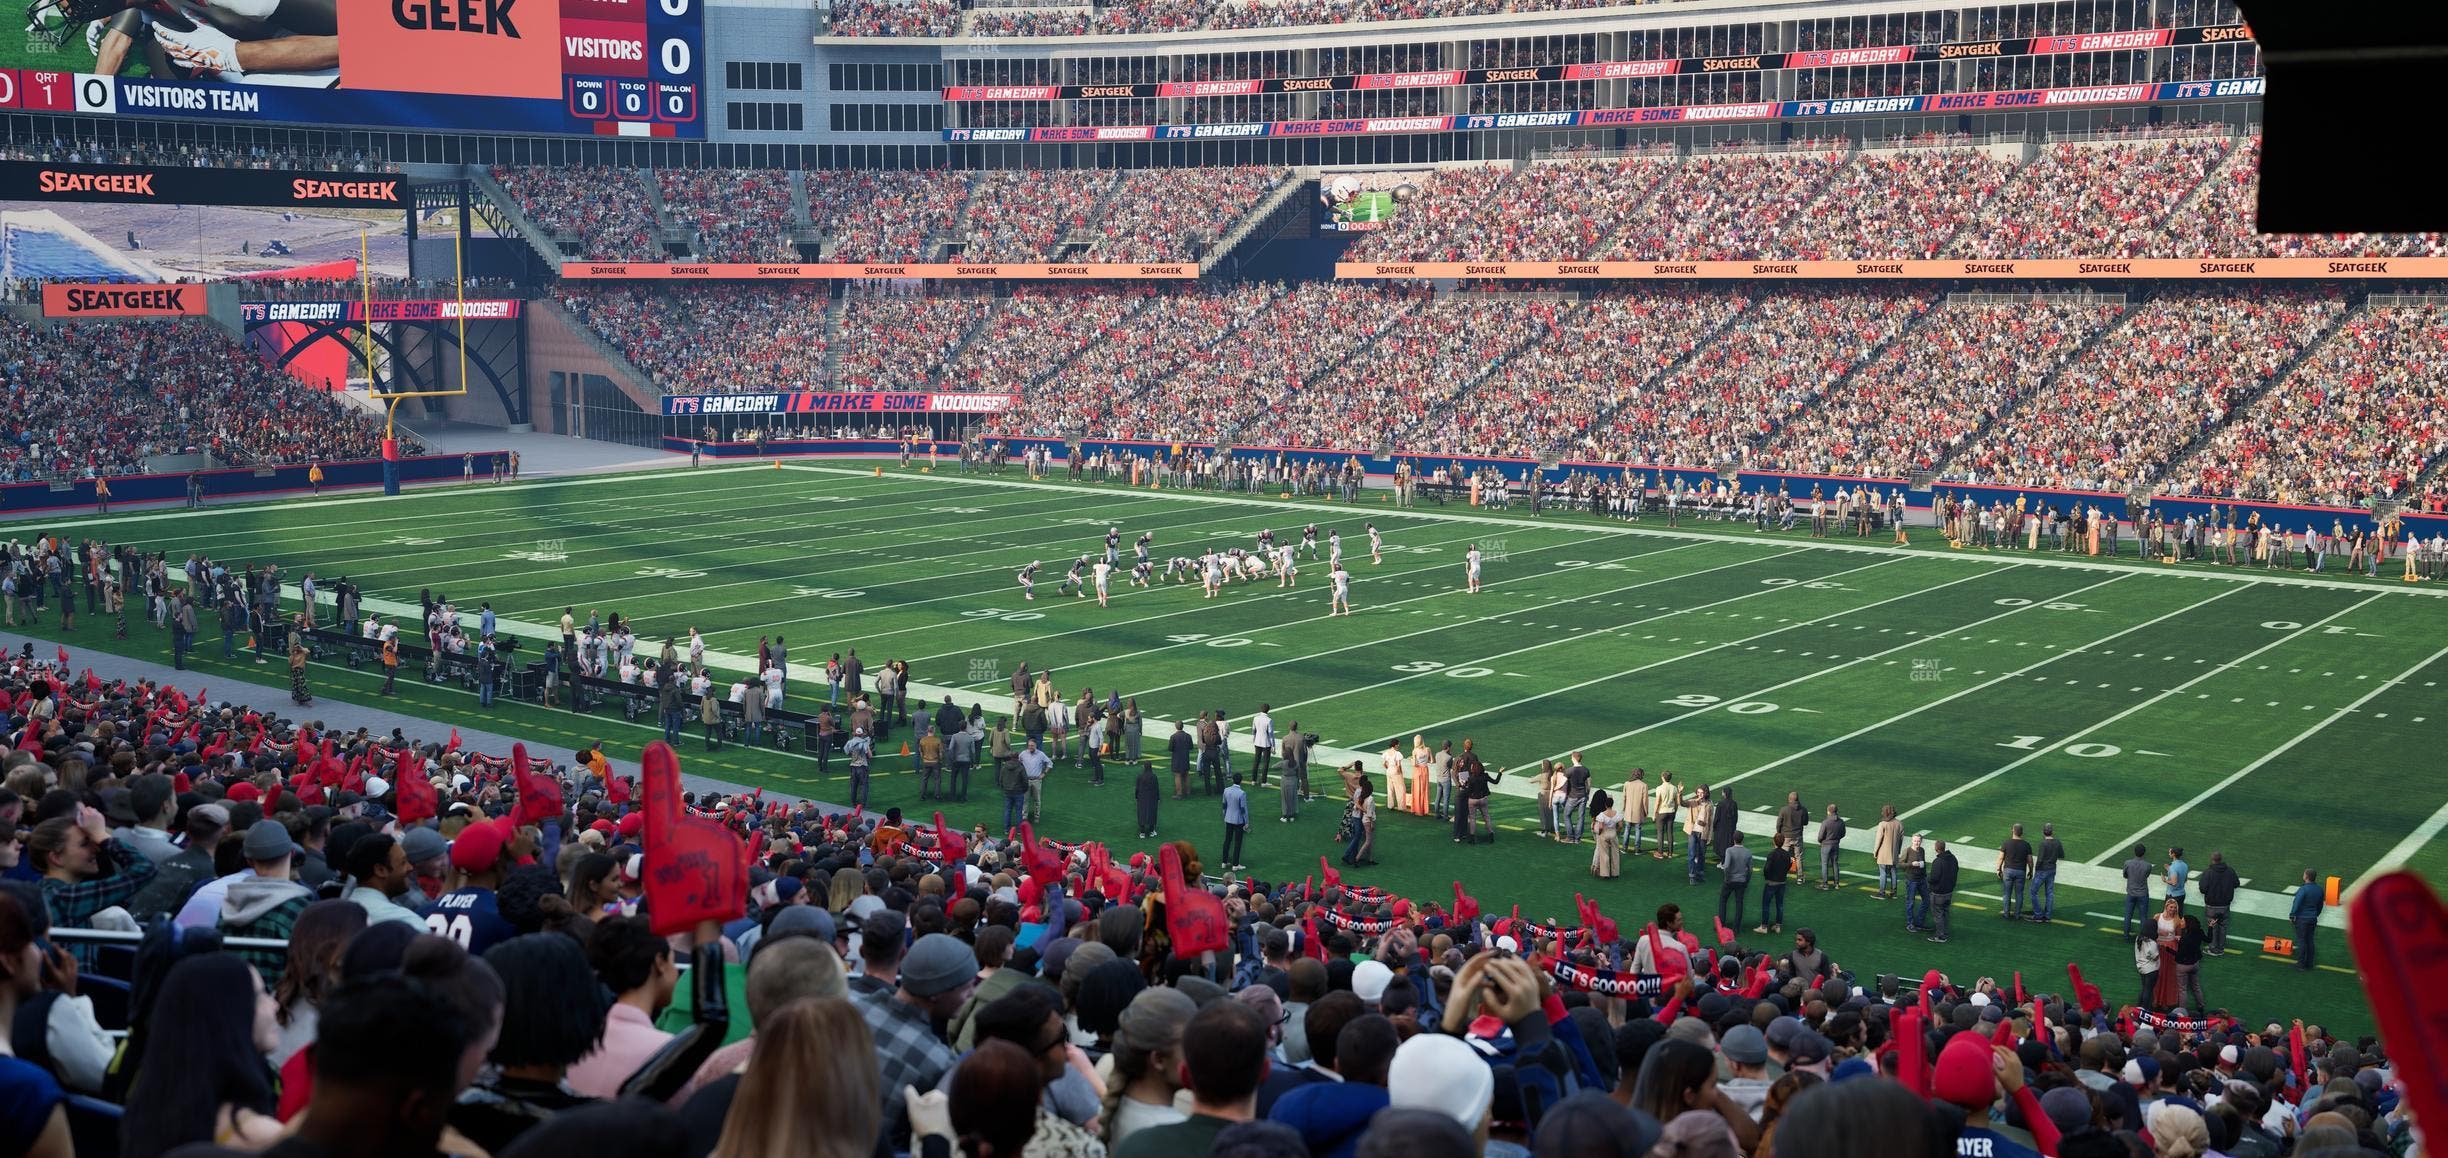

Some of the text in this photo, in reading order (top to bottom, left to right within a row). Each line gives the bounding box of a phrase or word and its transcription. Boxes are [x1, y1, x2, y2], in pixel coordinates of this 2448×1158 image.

[392, 0, 521, 39] GEEK
[565, 36, 643, 60] VISITORS
[2050, 32, 2159, 50] IT'S GAMEDAY!
[661, 38, 690, 74] 0
[1804, 50, 1900, 65] IT'S GAMEDAY!
[1940, 43, 2001, 58] SEATGEEK
[1580, 62, 1668, 77] IT'S GAMEDAY!
[1703, 58, 1760, 71] SEATGEEK
[36, 72, 58, 84] QRT
[1370, 74, 1454, 86] IT'S GAMEDAY!
[1486, 68, 1539, 82] SEATGEEK
[576, 80, 602, 90] DOWN
[620, 82, 646, 91] TO GO
[660, 84, 692, 93] BALL ON
[1172, 82, 1252, 95] IT'S GAMEDAY!
[1284, 78, 1332, 91] SEATGEEK
[2176, 83, 2211, 97] IT'S
[42, 86, 52, 106] 1
[83, 78, 109, 108] 0
[124, 84, 258, 112] VISITORS TEAM
[961, 87, 1048, 98] IT'S GAMEDAY!
[1082, 86, 1134, 98] SEATGEEK
[1938, 86, 2144, 108] MAKE SOME NOOOOISE!!!
[582, 92, 598, 110] 0
[625, 93, 640, 112] 0
[668, 95, 683, 114] 0
[1796, 98, 1914, 114] IT'S GAMEDAY!
[1467, 112, 1570, 128] IT'S GAMEDAY!
[1592, 105, 1768, 122] MAKE SOME NOOOOISE!!!
[1166, 124, 1264, 138] IT'S GAMEDAY!
[1284, 118, 1442, 134] MAKE SOME NOOOOISE!!!
[950, 128, 1026, 140] IT'S GAMEDAY!
[1040, 127, 1148, 140] MAKE SOME NOOOOISE!!!
[39, 170, 155, 196] SEATGEEK
[292, 179, 399, 202] SEATGEEK
[590, 266, 626, 275] SEATGEEK
[671, 266, 710, 275] SEATGEEK
[758, 266, 800, 275] SEATGEEK
[864, 266, 905, 275] SEATGEEK
[957, 266, 997, 275] SEATGEEK
[1048, 266, 1088, 275] SEATGEEK
[1141, 266, 1182, 275] SEATGEEK
[1376, 266, 1415, 275] SEATGEEK
[1466, 266, 1506, 274] SEATGEEK
[1558, 265, 1600, 275] SEATGEEK
[1654, 265, 1697, 274] SEATGEEK
[1753, 264, 1798, 274] SEATGEEK
[1856, 264, 1903, 274] SEATGEEK
[1965, 264, 2014, 274] SEATGEEK
[2079, 263, 2132, 274] SEATGEEK
[2200, 262, 2256, 274] SEATGEEK
[2328, 262, 2388, 274] SEATGEEK
[67, 288, 184, 312] SEATGEEK
[269, 303, 340, 320] GAMEDAY!
[404, 302, 438, 318] SOME
[671, 396, 778, 414] IT'S GAMEDAY!
[808, 396, 875, 410] MAKE
[882, 395, 927, 410] SOME
[960, 608, 1046, 622] 50
[1165, 634, 1254, 648] 40
[1391, 661, 1495, 678] 30
[1660, 694, 1780, 714] 20
[1995, 735, 2122, 758] 10
[900, 842, 916, 856] LET'S
[438, 894, 478, 908] PLAYER
[1324, 911, 1348, 929] LET'S
[1526, 923, 1542, 936] LET'S
[1555, 961, 1662, 995] LET'S GOOOOO!!!
[2138, 1010, 2162, 1026] LET'S
